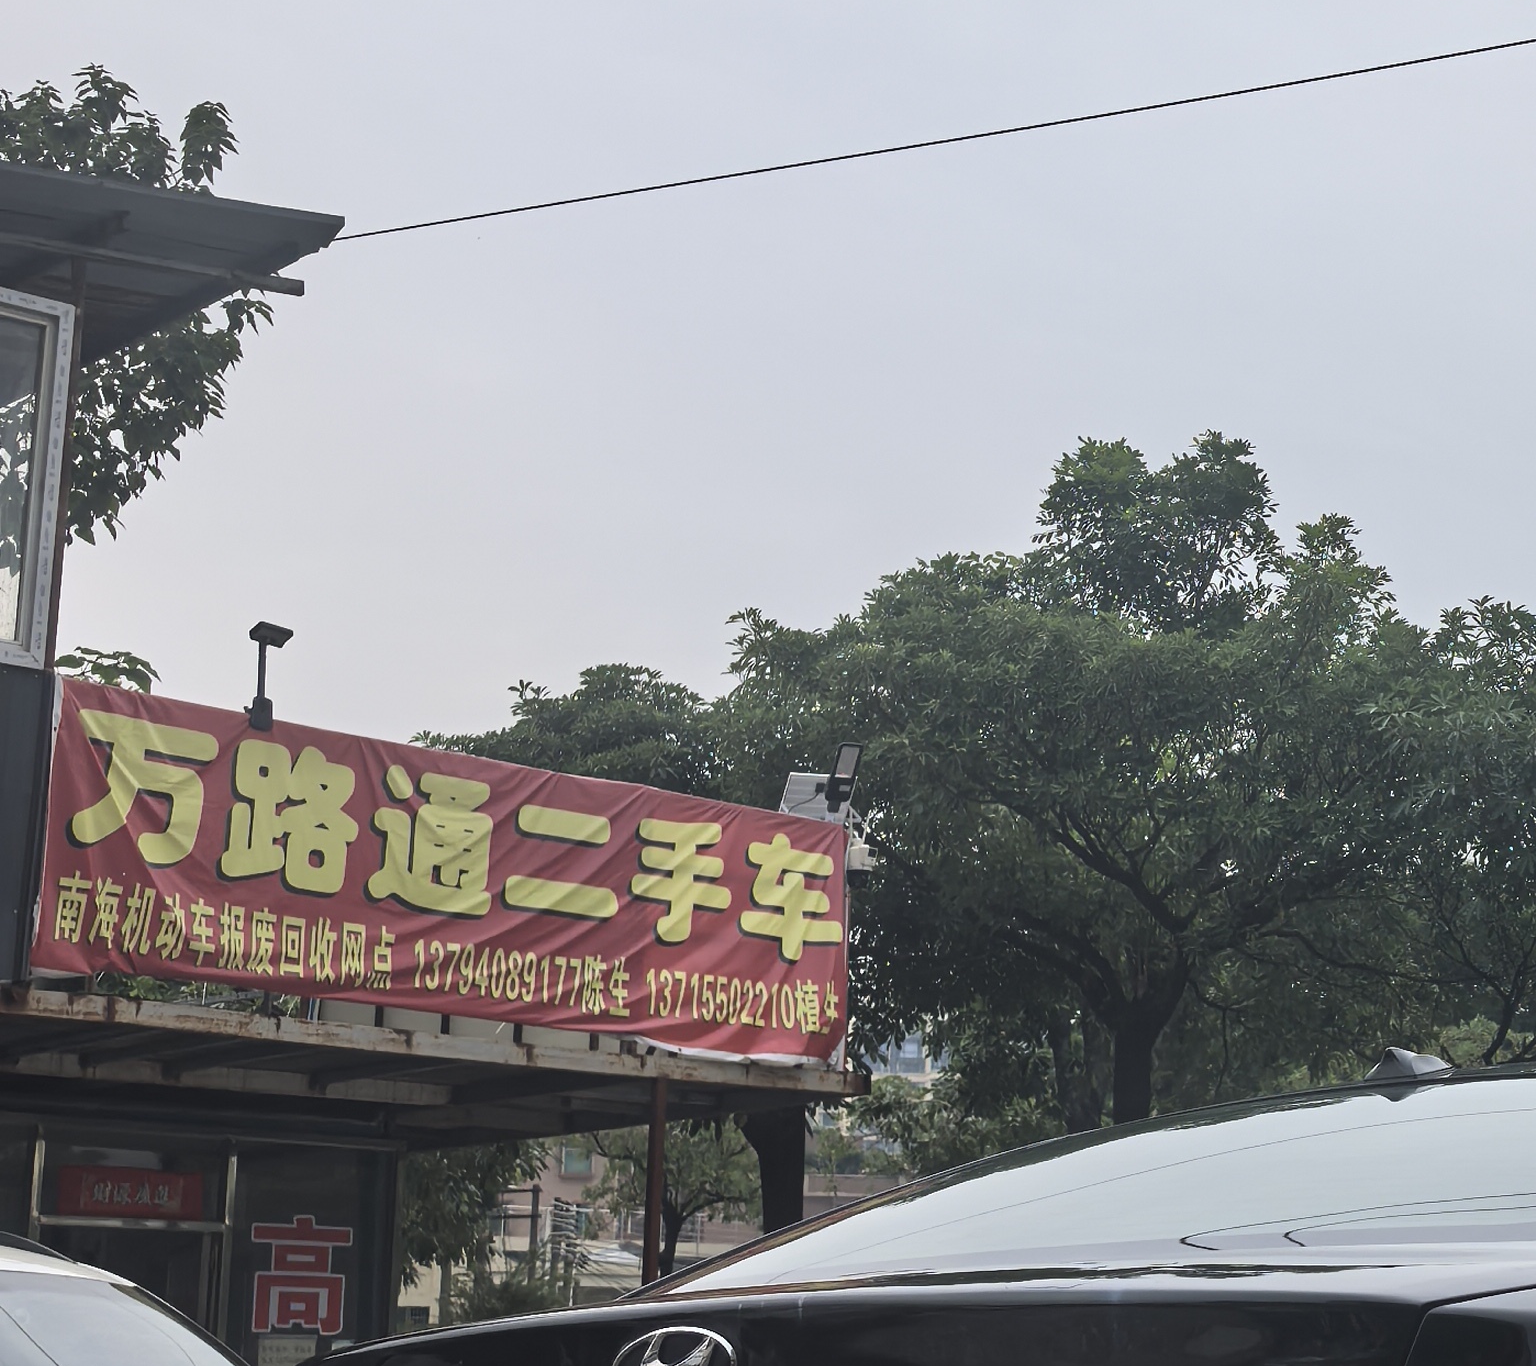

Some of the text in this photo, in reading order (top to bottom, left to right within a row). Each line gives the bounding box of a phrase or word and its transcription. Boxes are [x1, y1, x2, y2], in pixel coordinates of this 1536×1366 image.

[72, 708, 843, 961] 万路通二手车
[54, 870, 396, 991] 南海机动车报废回收网点
[413, 938, 631, 1017] 13794089177陈生
[252, 1214, 353, 1335] 高
